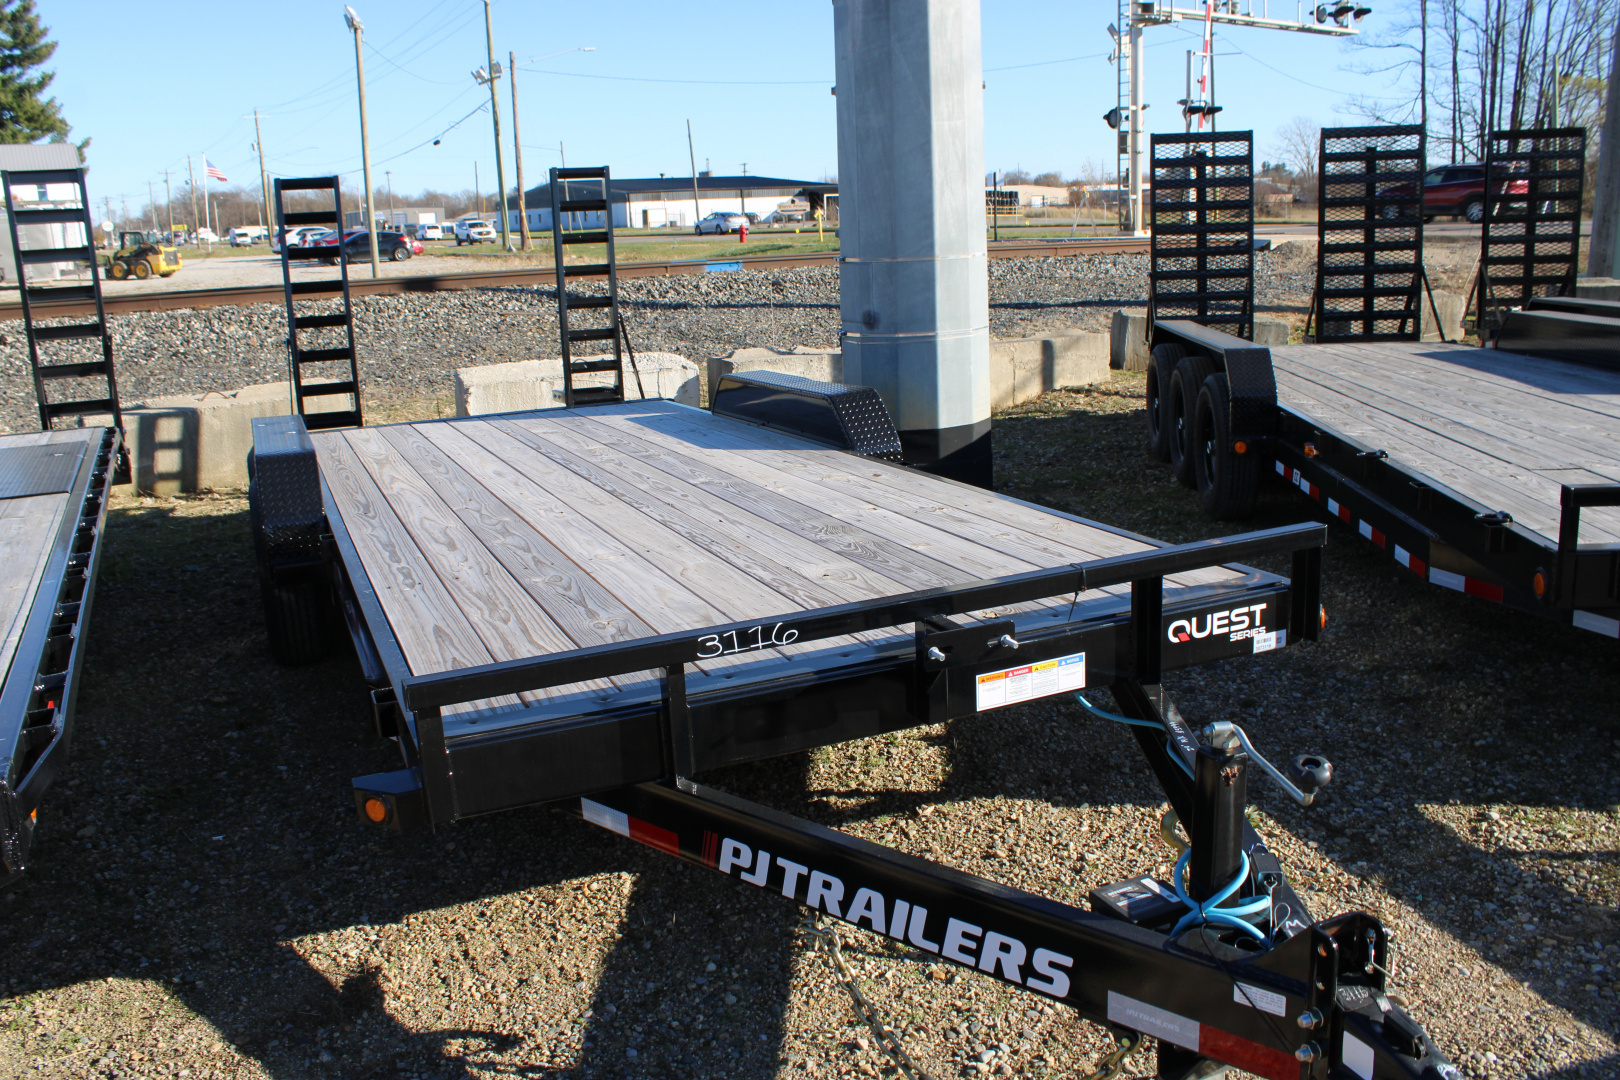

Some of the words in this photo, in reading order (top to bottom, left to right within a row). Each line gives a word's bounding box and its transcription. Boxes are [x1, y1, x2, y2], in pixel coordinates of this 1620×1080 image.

[697, 622, 798, 658] 3116
[1167, 603, 1267, 643] QUEST
[1229, 626, 1267, 642] SERIES
[719, 837, 770, 887] PJ
[777, 856, 1074, 998] TRAILERS
